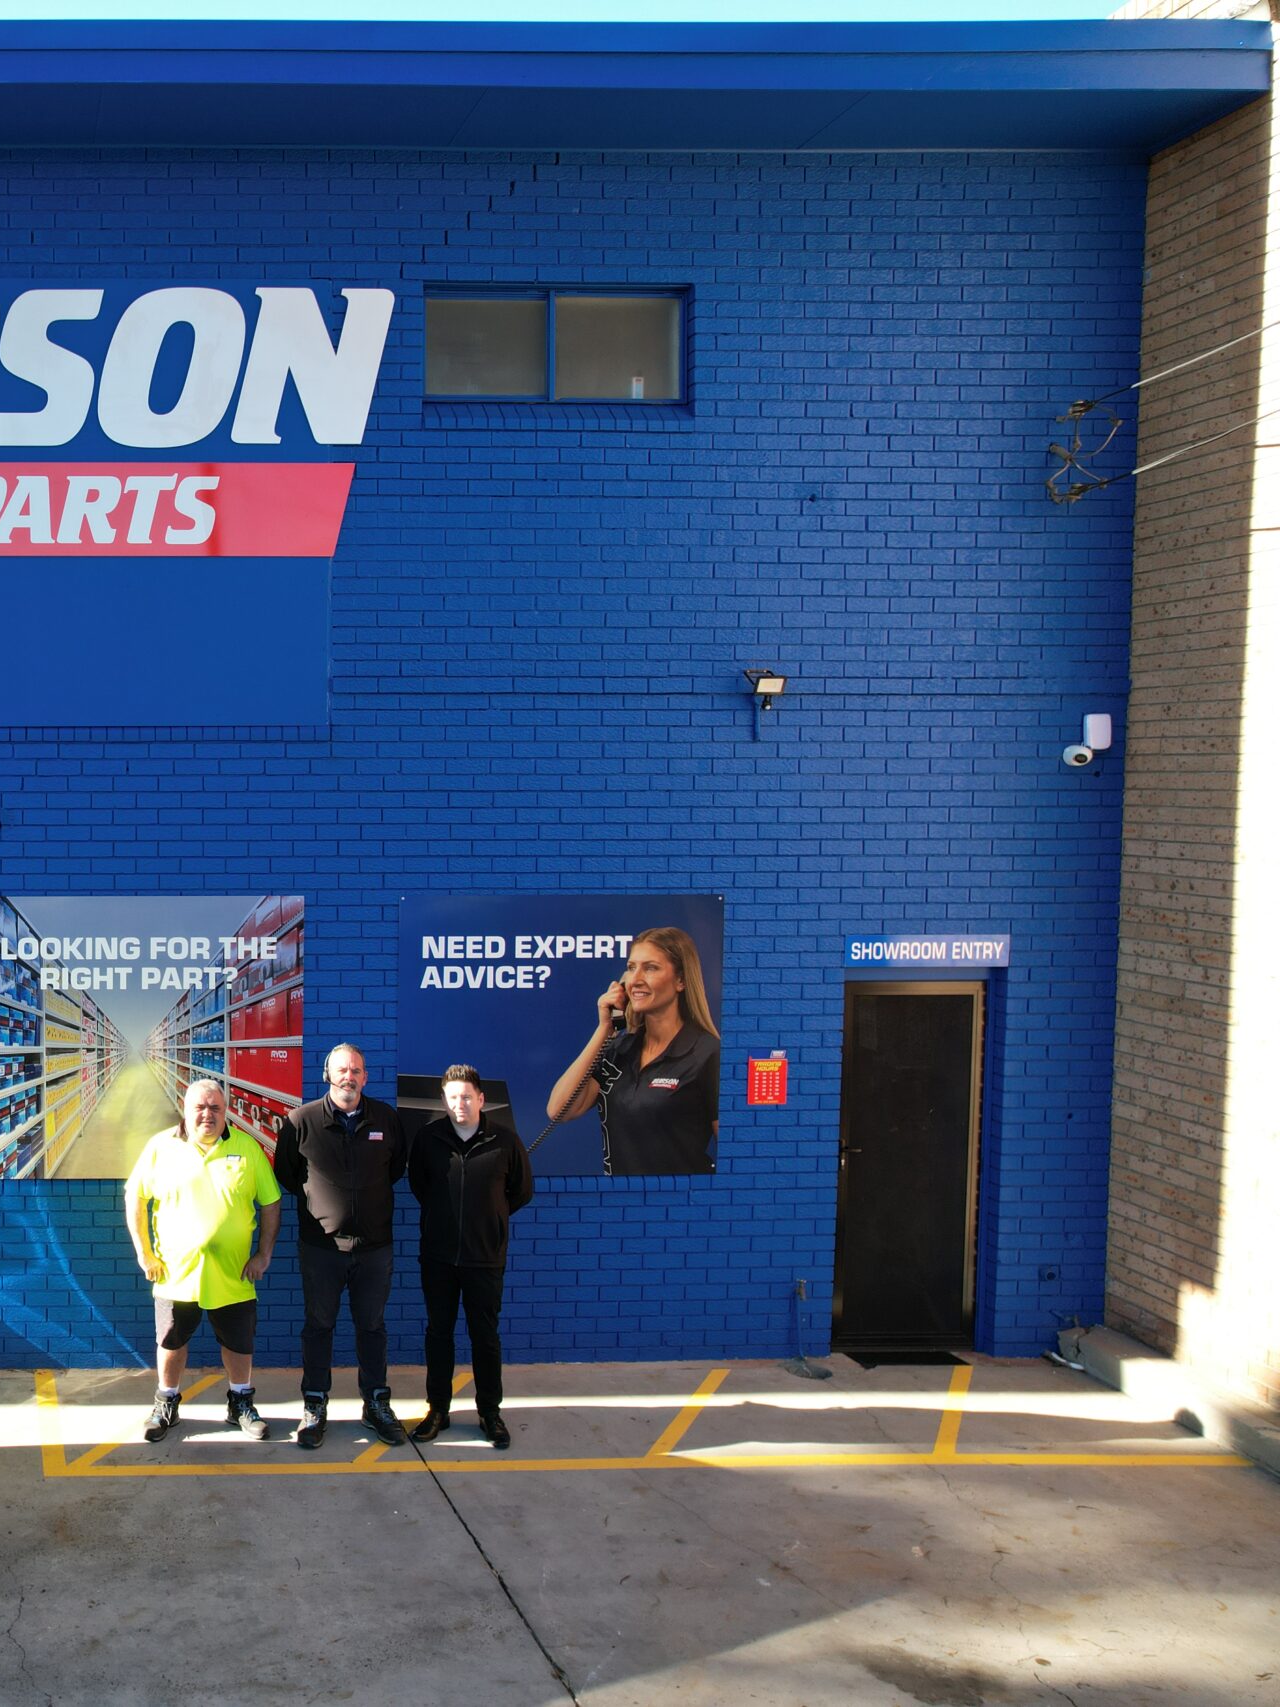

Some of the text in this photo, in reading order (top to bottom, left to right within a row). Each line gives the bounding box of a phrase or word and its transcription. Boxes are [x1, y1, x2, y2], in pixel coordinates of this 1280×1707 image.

[1, 937, 278, 960] LOOKING FOR THE
[422, 935, 633, 959] NEED EXPERT
[851, 942, 1004, 960] SHOWROOM ENTRY
[40, 967, 238, 990] RIGHT PART?
[420, 965, 551, 989] ADVICE?
